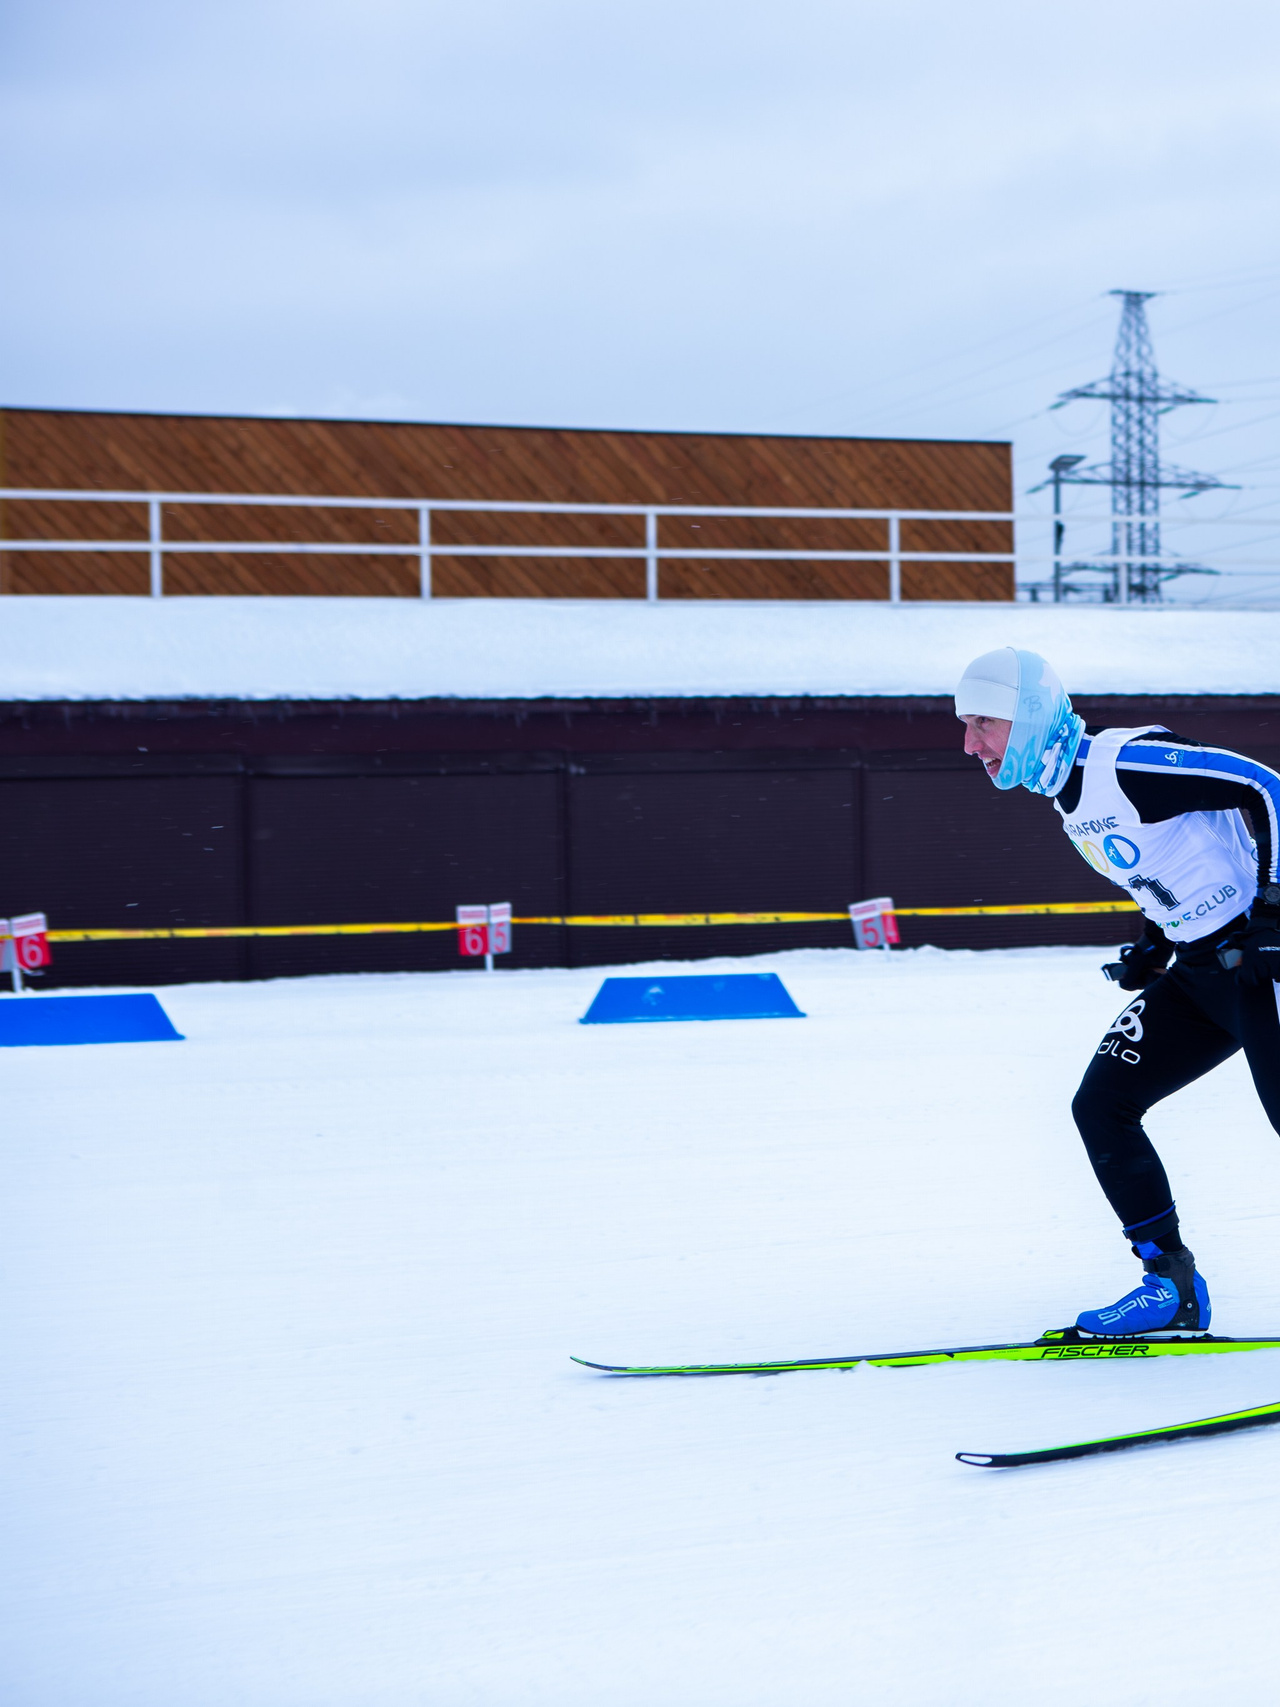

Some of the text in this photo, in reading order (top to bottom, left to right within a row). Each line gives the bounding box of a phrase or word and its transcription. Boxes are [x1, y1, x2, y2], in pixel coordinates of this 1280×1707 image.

[1065, 815, 1120, 837] RAFONE
[465, 926, 484, 955] 6
[494, 922, 508, 953] 5
[862, 917, 879, 947] 5
[21, 935, 43, 968] 6
[1097, 1039, 1141, 1065] dlo
[1098, 1287, 1173, 1326] SPINE
[1041, 1345, 1150, 1359] FISCHER
